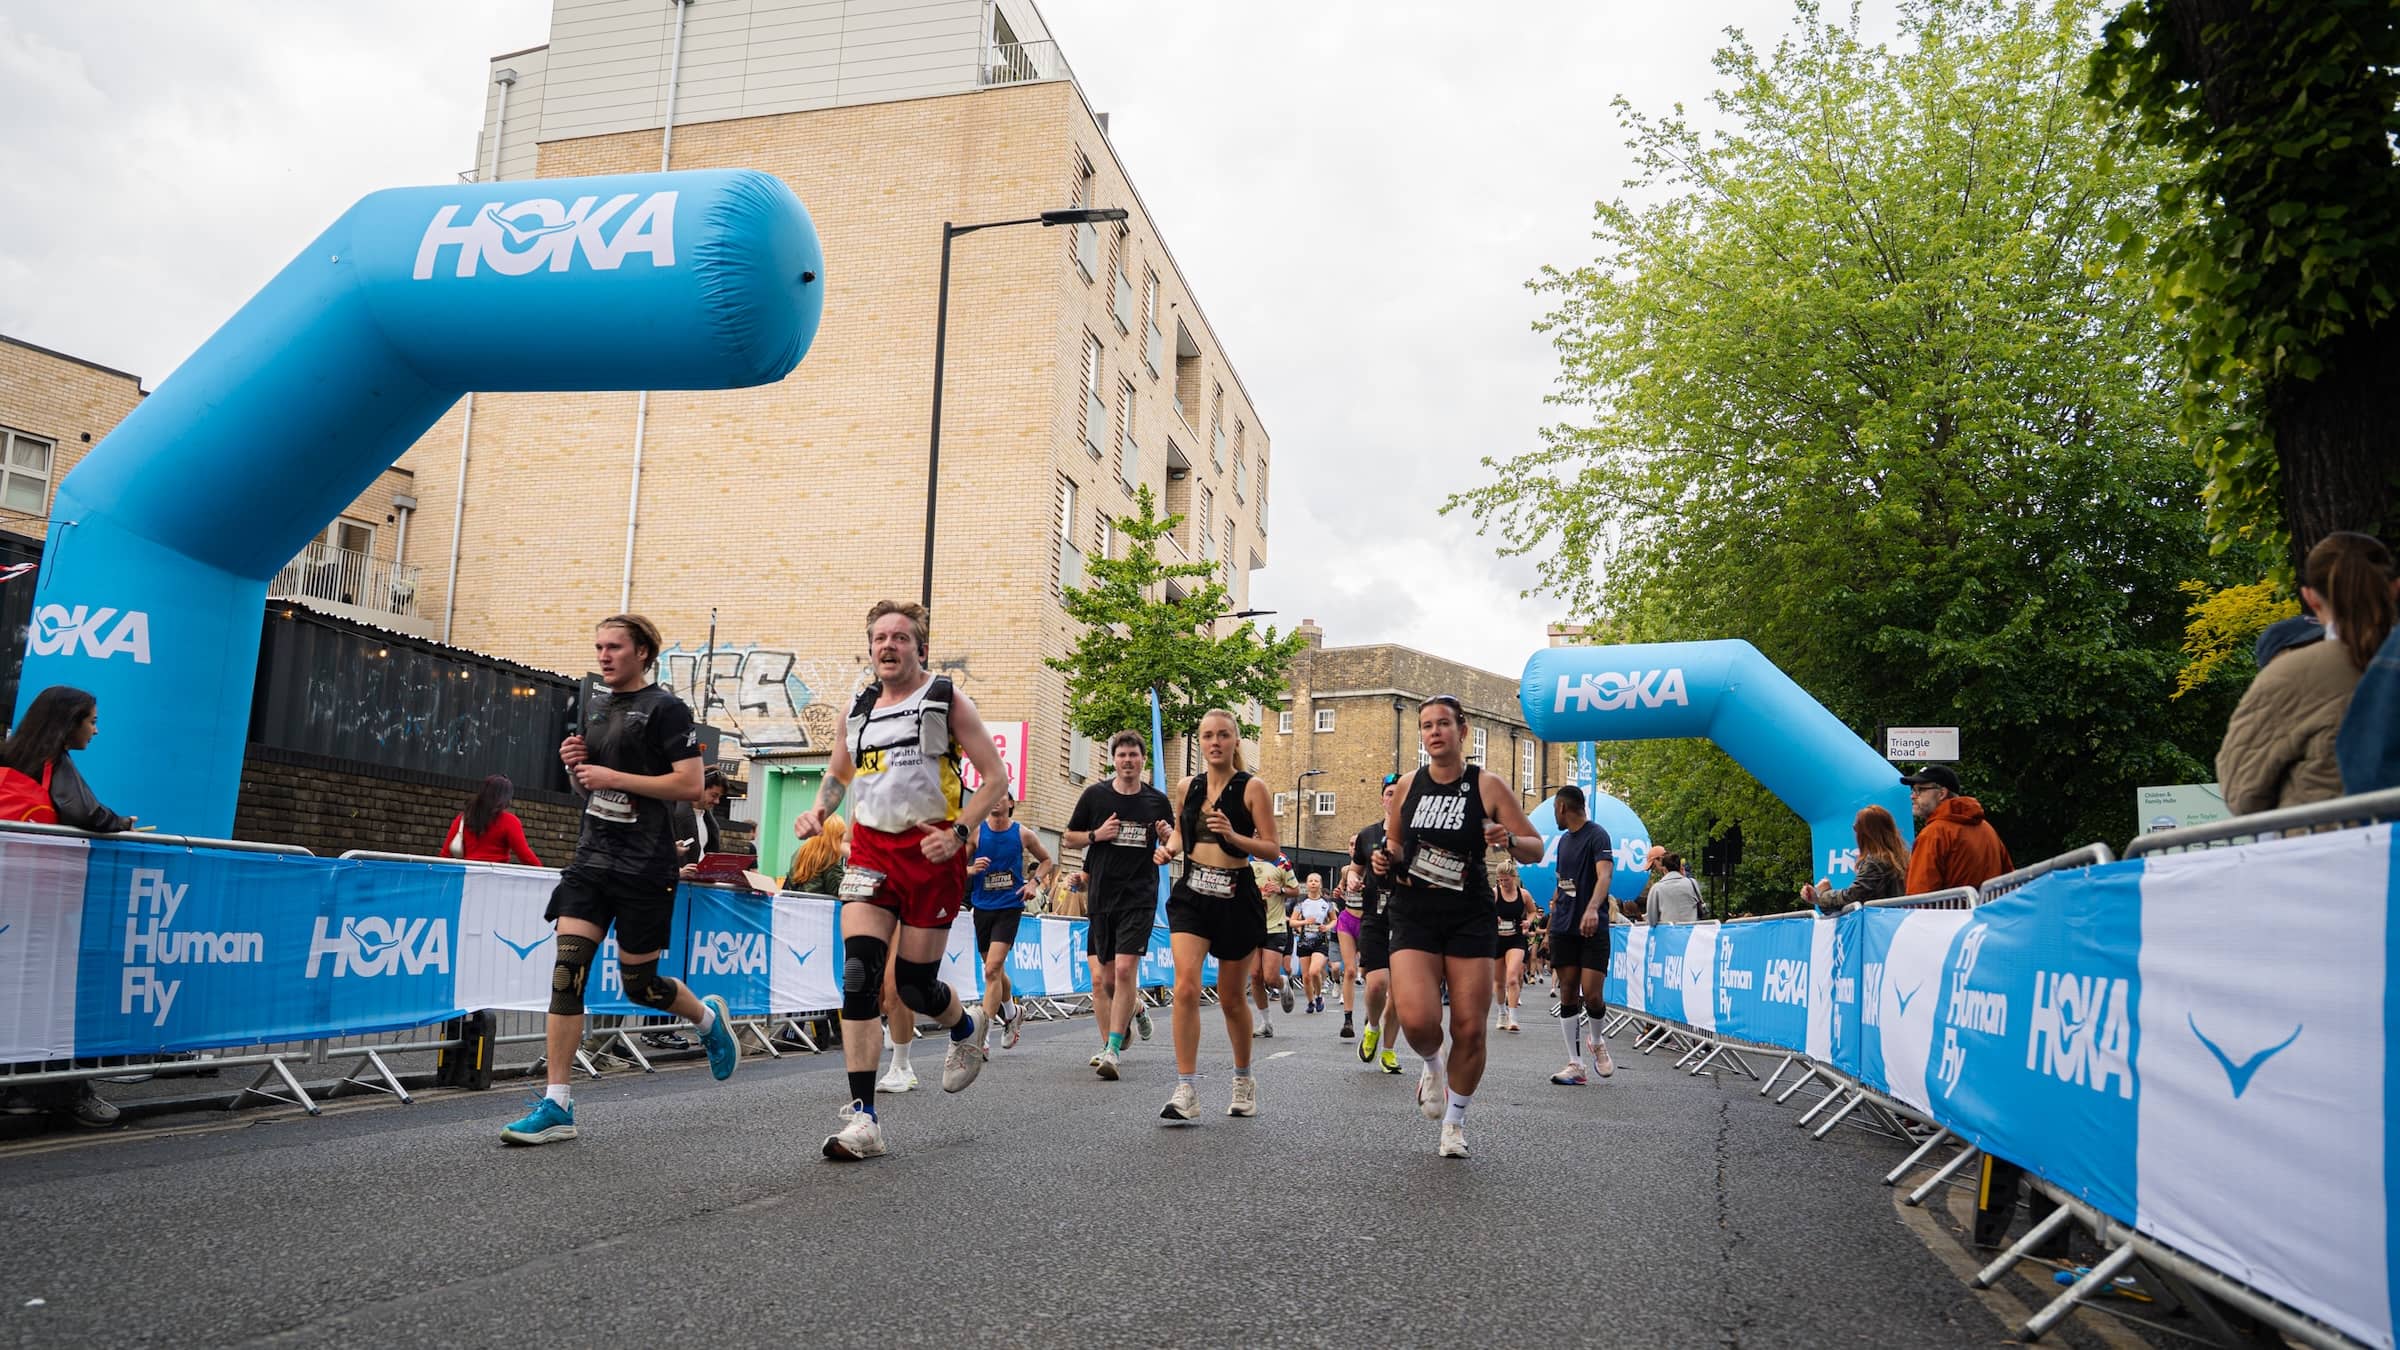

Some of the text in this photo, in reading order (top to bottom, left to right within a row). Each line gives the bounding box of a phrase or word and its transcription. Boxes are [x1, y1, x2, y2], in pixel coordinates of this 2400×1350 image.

[413, 191, 679, 280] HOKA
[1554, 668, 1689, 713] HOKA
[1890, 738, 1930, 748] Triangle
[1890, 748, 1915, 756] Road
[1410, 809, 1465, 830] MOVES
[1419, 795, 1467, 813] MAFIA
[128, 868, 188, 928] Fly
[123, 917, 264, 963] Human
[305, 916, 449, 978] HOKA
[690, 931, 767, 975] HOKA
[1014, 942, 1041, 970] HOKA
[1721, 935, 1734, 969] Fly
[1955, 923, 1988, 985] Fly
[1664, 955, 1683, 991] HOKA
[1720, 961, 1752, 990] Human
[1762, 959, 1808, 1008] HOKA
[121, 966, 181, 1026] Fly
[1719, 988, 1732, 1022] Fly
[1946, 971, 2007, 1037] Human
[2026, 970, 2133, 1101] HOKA
[1938, 1027, 1966, 1099] Fly
